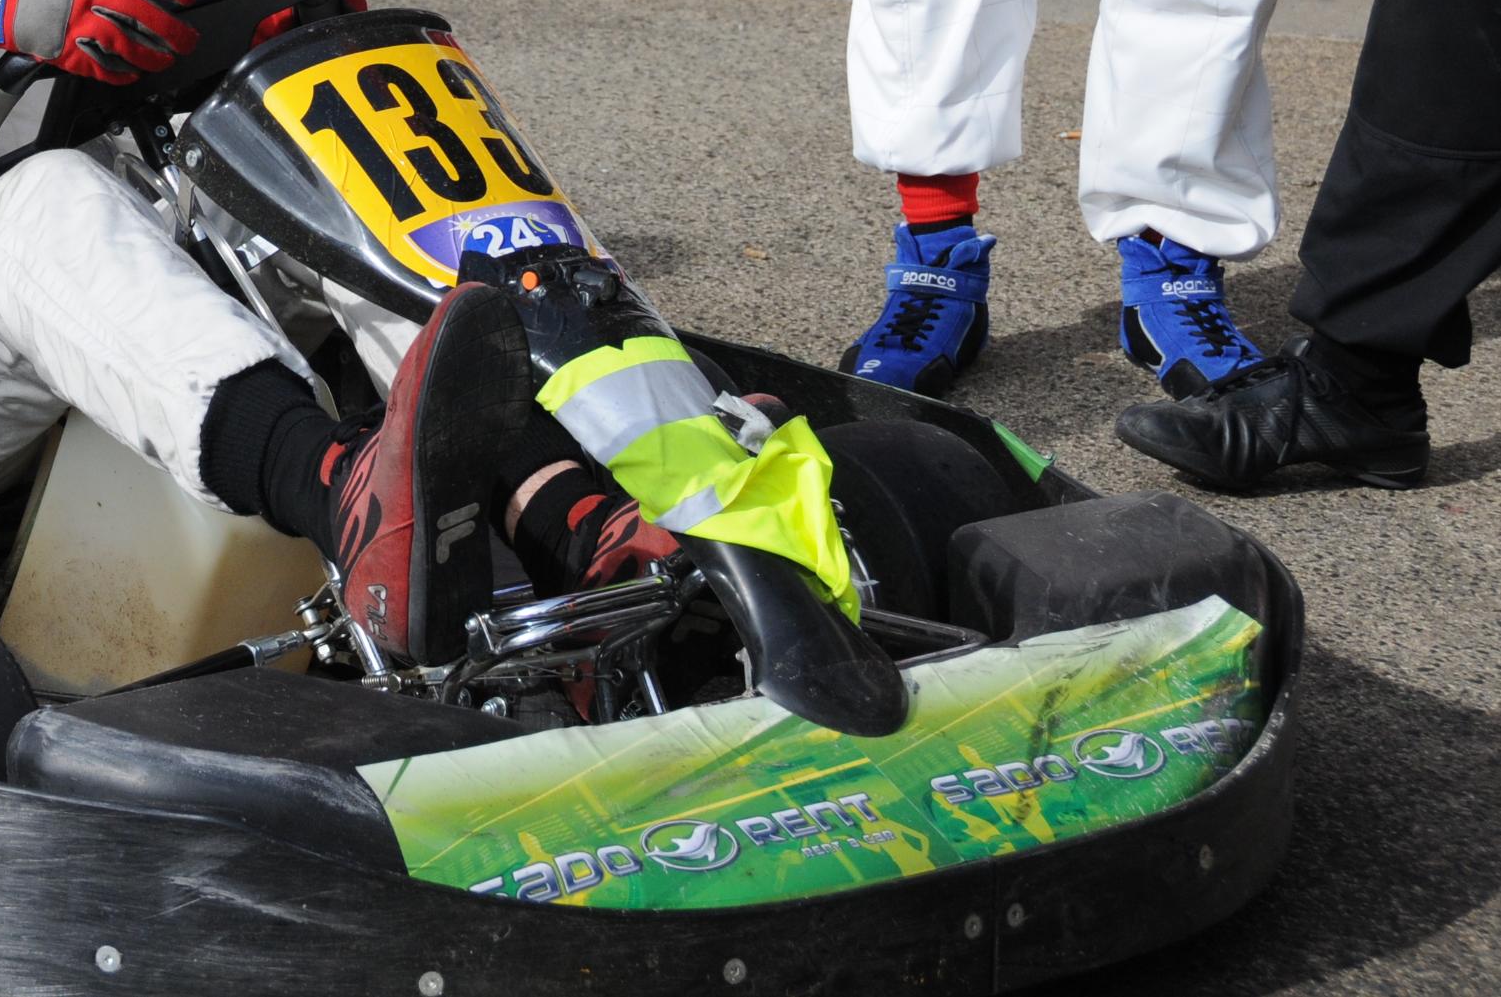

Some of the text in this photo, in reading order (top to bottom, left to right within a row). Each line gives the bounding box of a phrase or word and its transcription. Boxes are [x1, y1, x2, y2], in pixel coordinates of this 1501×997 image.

[300, 59, 555, 222] 133
[901, 271, 957, 291] sparco
[367, 584, 388, 641] FILA
